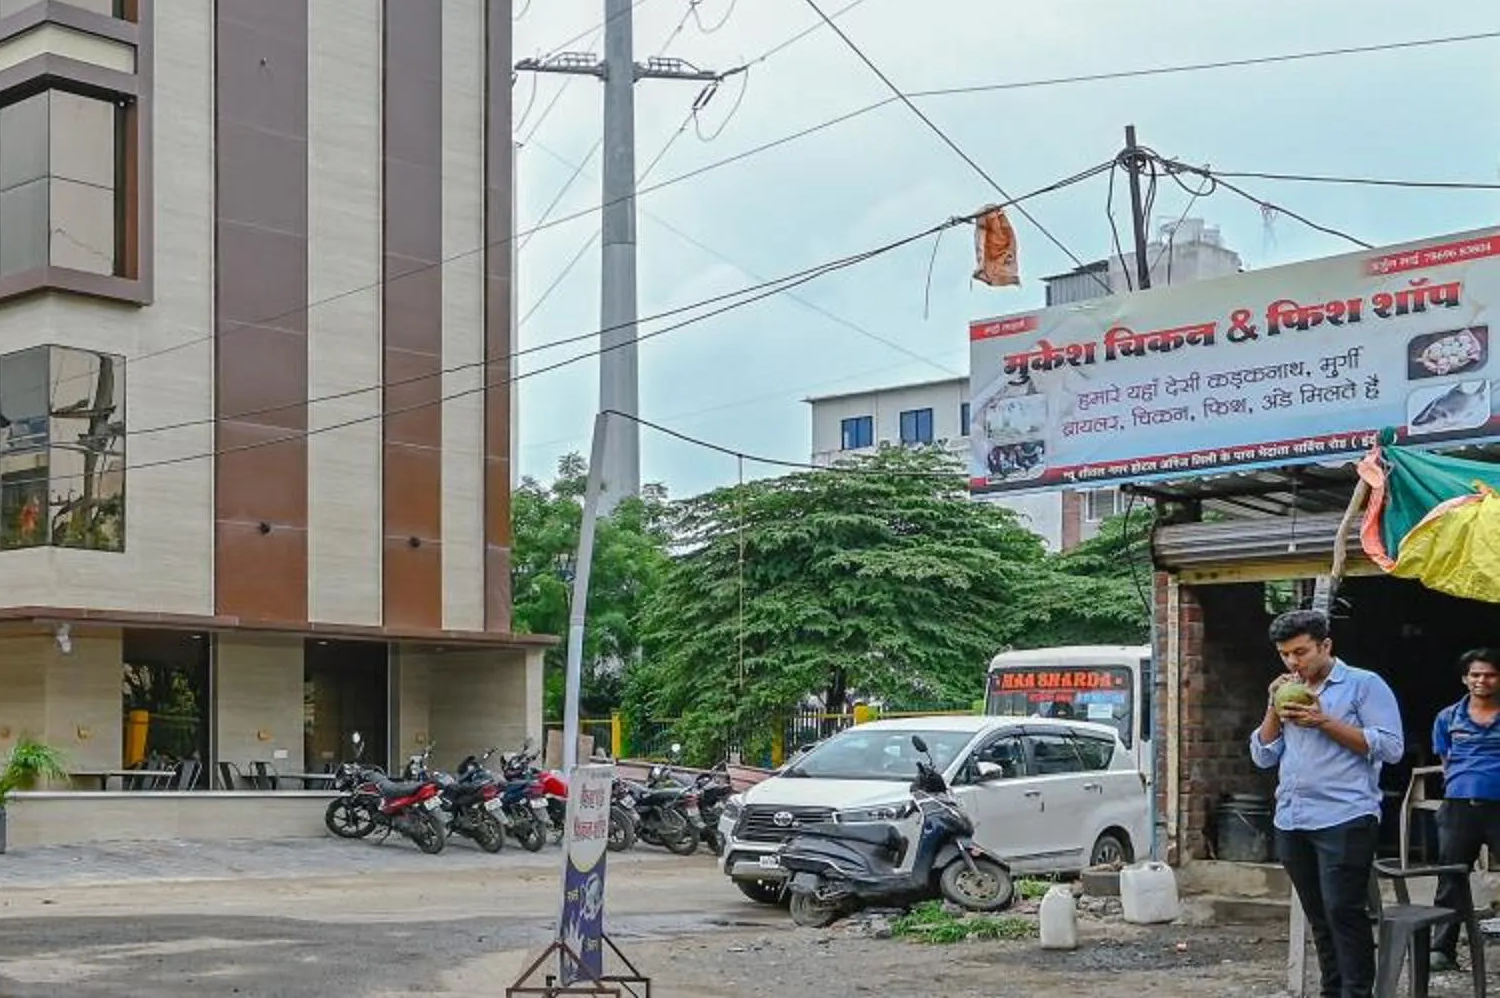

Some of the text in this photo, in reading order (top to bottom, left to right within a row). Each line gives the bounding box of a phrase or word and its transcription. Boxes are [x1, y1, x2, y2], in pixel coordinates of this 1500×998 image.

[1003, 277, 1463, 386] मुकेश चिकन & फिश शॉप
[1077, 383, 1122, 411] हमारे
[1165, 371, 1201, 396] देसी
[1319, 345, 1364, 379] मुर्गी
[1300, 378, 1357, 405] मिलते
[1234, 448, 1255, 461] पास
[1037, 670, 1112, 689] SHARDA
